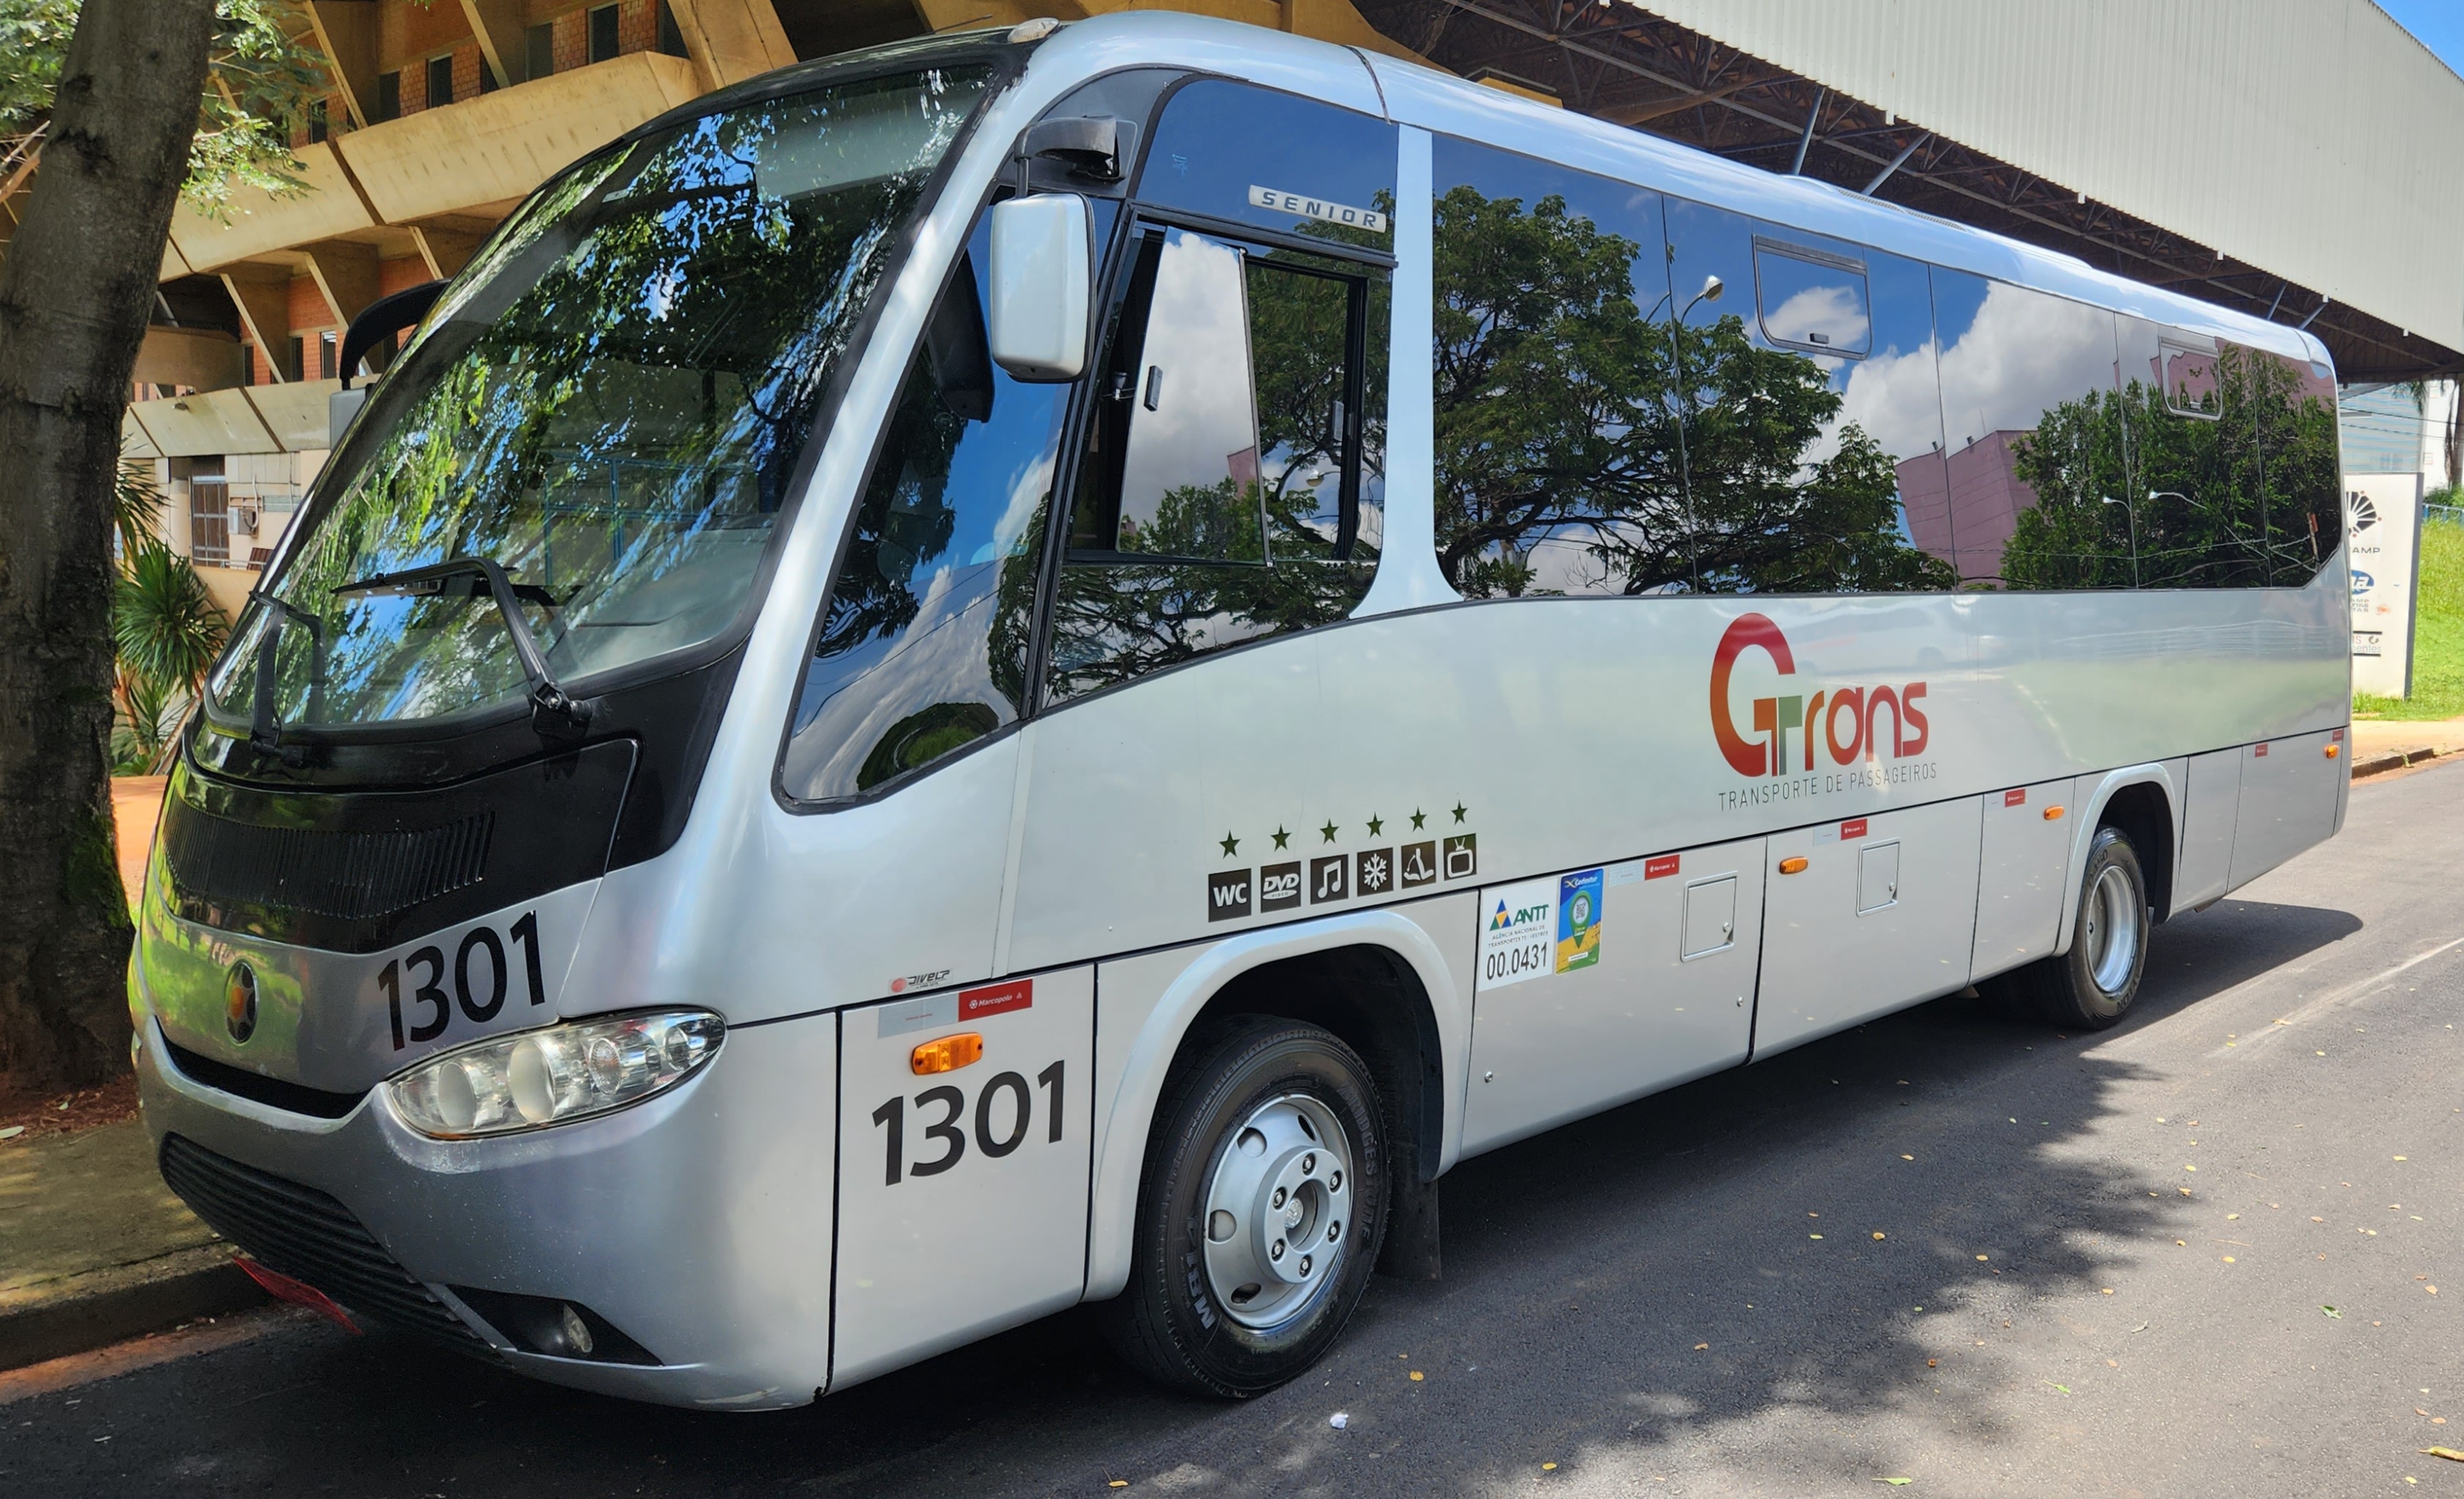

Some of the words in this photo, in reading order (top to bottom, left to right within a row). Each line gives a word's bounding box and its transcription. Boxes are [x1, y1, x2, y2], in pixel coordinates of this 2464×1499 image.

[1262, 191, 1376, 228] SENIOR
[1719, 777, 1818, 811] TRANSPORTE
[1827, 774, 1843, 793] DE
[1850, 762, 1937, 791] PASSAGEIROS
[1213, 882, 1247, 907] WC
[1263, 873, 1299, 893] DVD
[1513, 904, 1549, 926] ANTT
[1488, 936, 1521, 948] TRANSPORTES
[1521, 931, 1549, 940] TEESTRES
[1514, 926, 1538, 935] NACIONAL
[1487, 942, 1547, 981] 00.0431
[378, 910, 545, 1052] 1301
[978, 994, 1012, 1007] Marcopolo
[872, 1060, 1064, 1187] 1301
